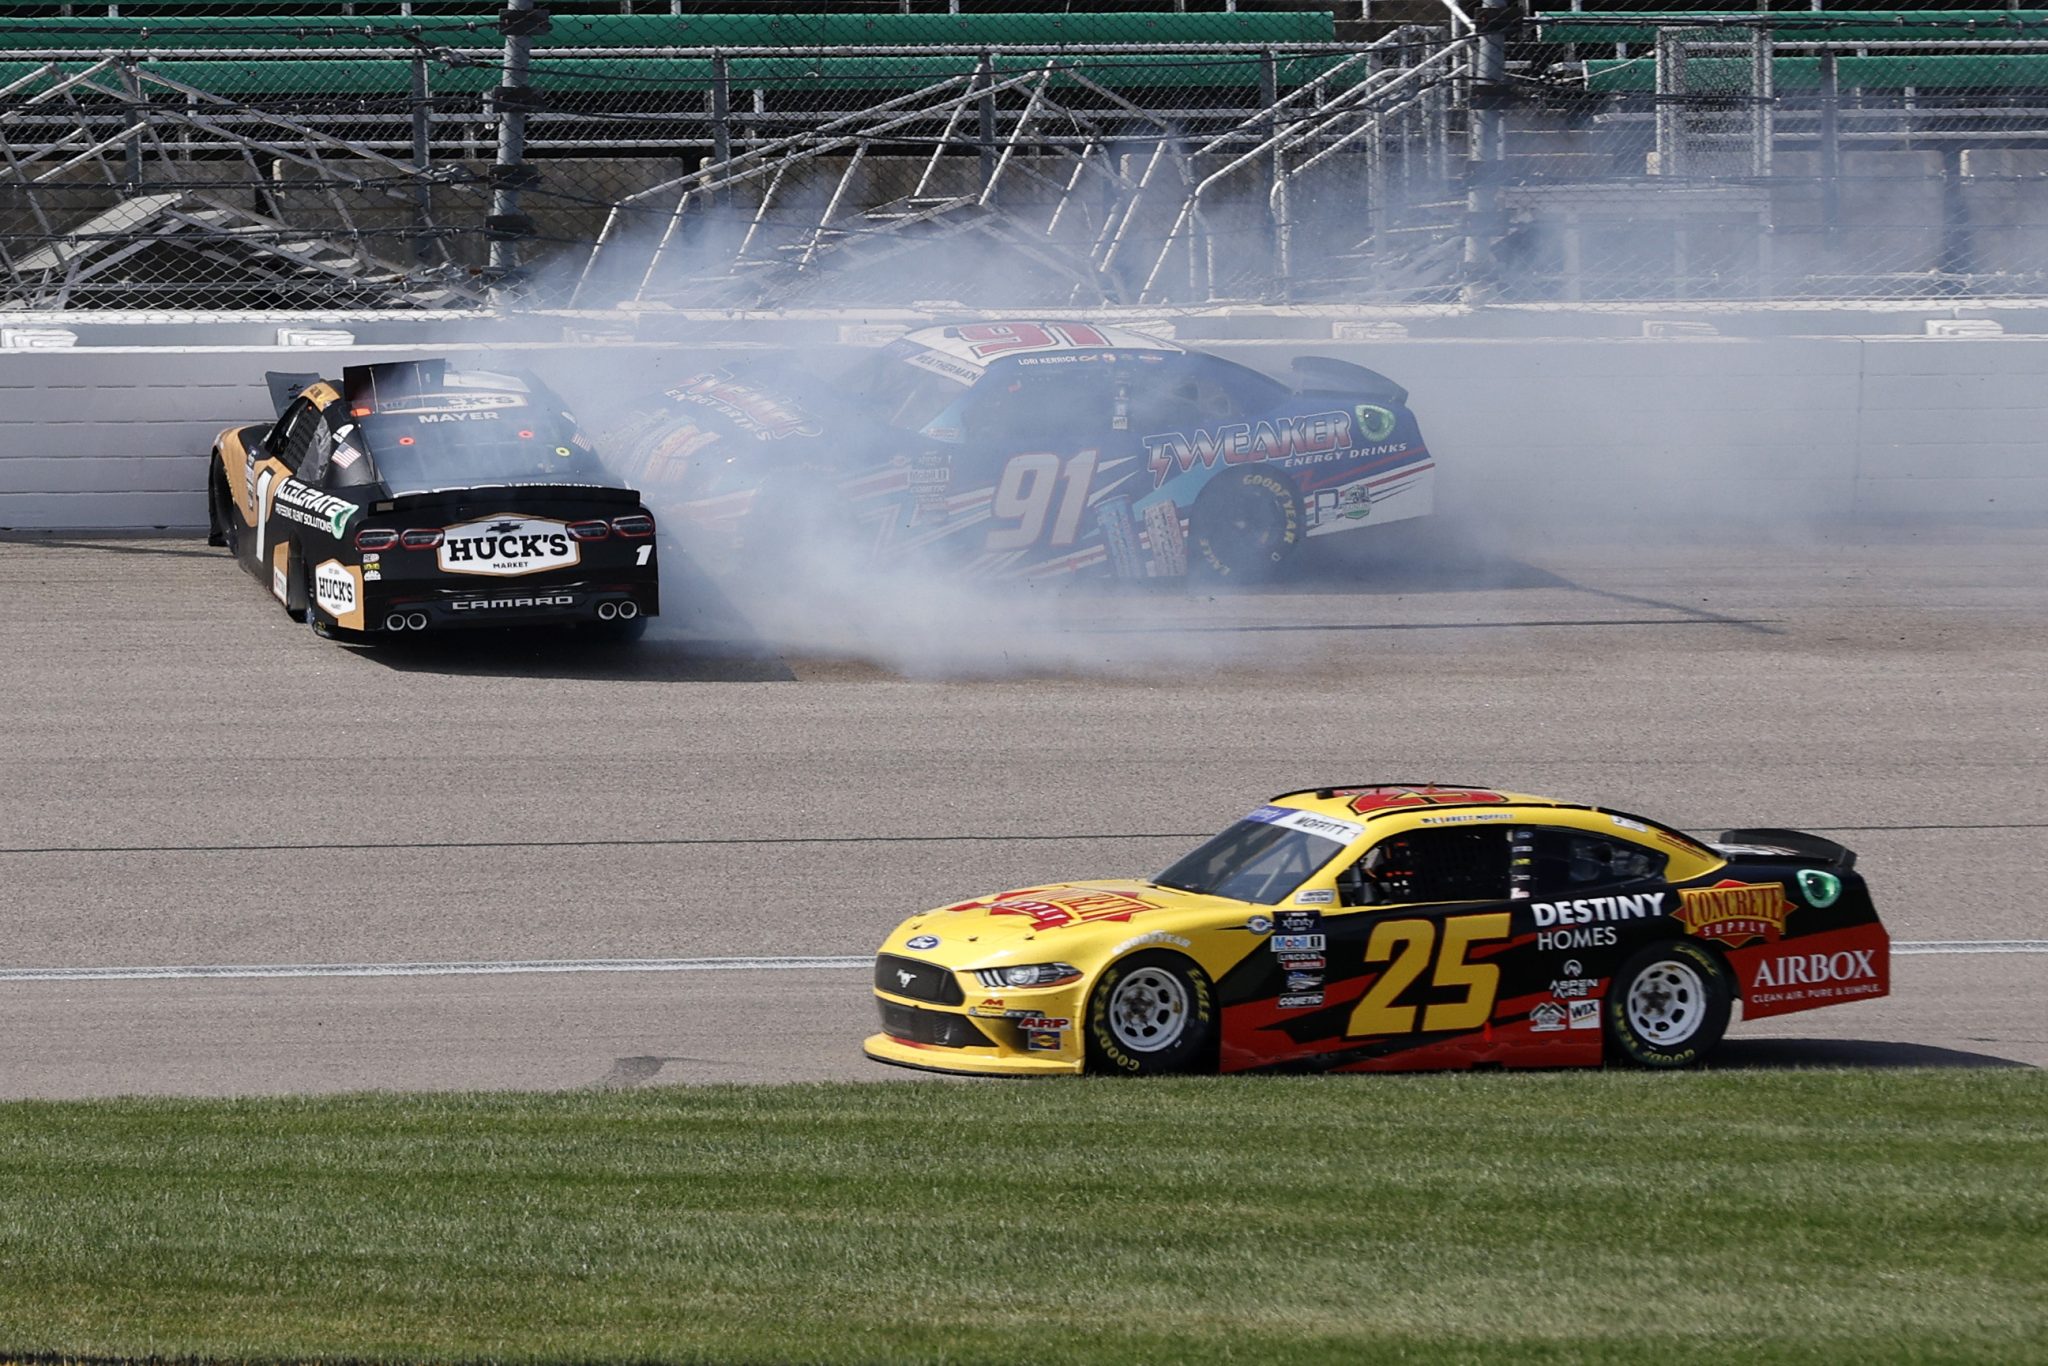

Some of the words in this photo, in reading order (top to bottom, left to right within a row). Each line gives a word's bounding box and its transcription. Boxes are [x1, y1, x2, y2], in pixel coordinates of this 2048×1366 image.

[915, 354, 980, 381] WEATHERMAN
[1040, 356, 1078, 365] KERRICK
[418, 411, 500, 424] MAYER
[1142, 410, 1353, 489] TWEAKER
[1284, 452, 1344, 468] ENERGY
[1349, 442, 1408, 459] DRINKS
[987, 447, 1099, 550] 91
[1243, 474, 1296, 544] GOODYEAR
[256, 467, 274, 563] 1
[447, 534, 569, 562] HUCK'S
[636, 544, 653, 566] 1
[493, 561, 529, 569] MARKET
[318, 577, 353, 604] HUCK'S
[452, 596, 574, 610] CAMARO
[1294, 817, 1350, 836] MOFFITT
[1530, 892, 1665, 926] DESTINY
[1687, 888, 1783, 926] CONCRETE
[1282, 917, 1315, 930] xfinity
[1704, 921, 1766, 937] SUPPLY
[1274, 937, 1308, 948] Mobil
[1537, 926, 1618, 951] HOMES
[1280, 953, 1317, 961] LINCOLN
[1346, 912, 1512, 1037] 25
[1752, 949, 1877, 988] AIRBOX
[1549, 979, 1599, 990] ASPEN
[1752, 993, 1784, 1003] CLEAN
[1786, 991, 1806, 1001] AIR.
[1808, 988, 1833, 998] PURE
[1836, 988, 1844, 996] &
[1845, 984, 1883, 995] SIMPLE.
[1571, 1003, 1597, 1018] WIX
[1020, 1018, 1070, 1028] ARP
